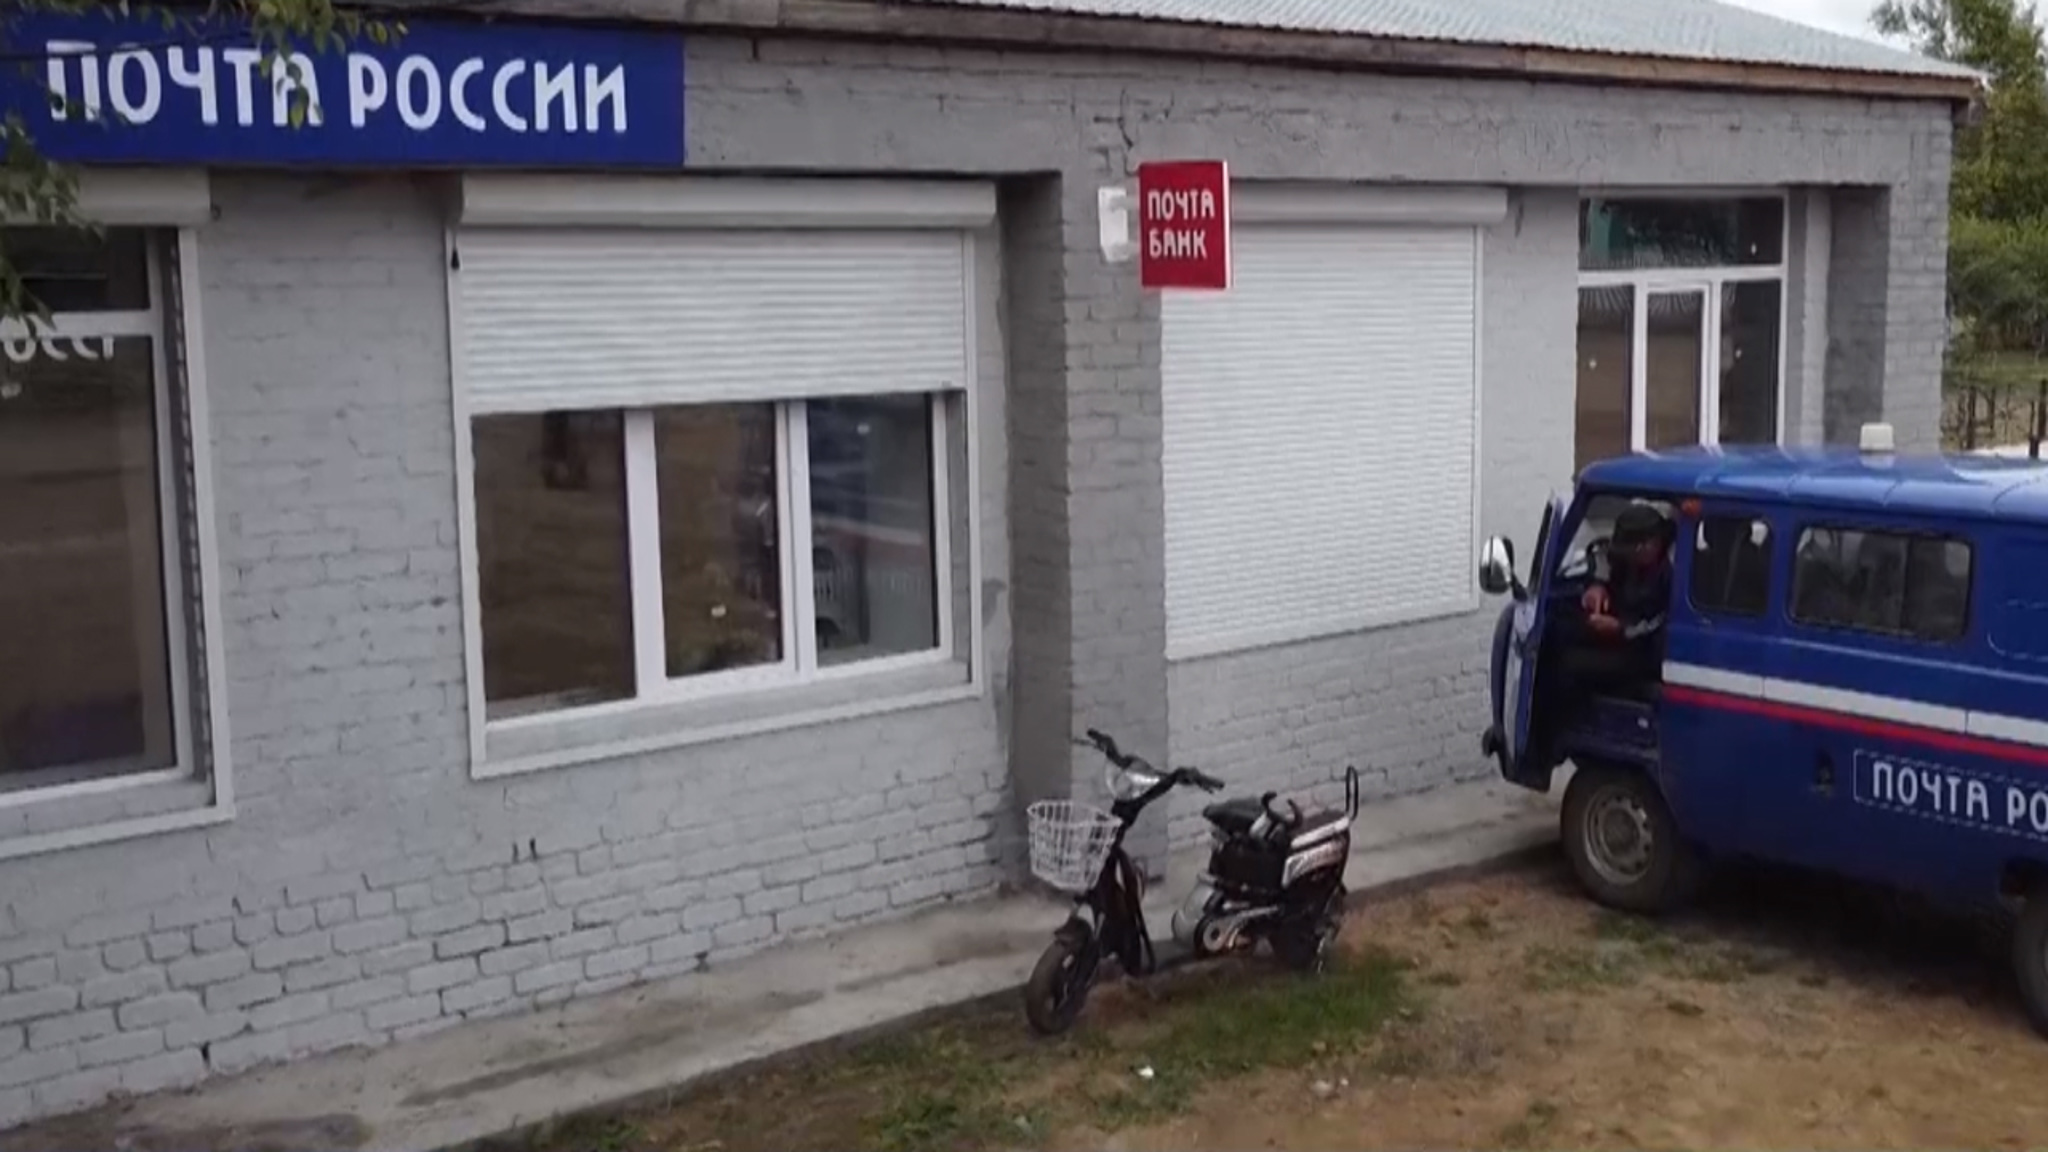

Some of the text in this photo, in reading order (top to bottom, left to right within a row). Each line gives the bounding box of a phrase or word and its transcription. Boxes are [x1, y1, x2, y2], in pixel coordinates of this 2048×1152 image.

[46, 40, 628, 134] ПОЧТА РОССИИ
[1148, 189, 1215, 220] ПОЧТА
[1149, 228, 1208, 259] БАНК
[1872, 761, 1990, 821] ПОЧТА
